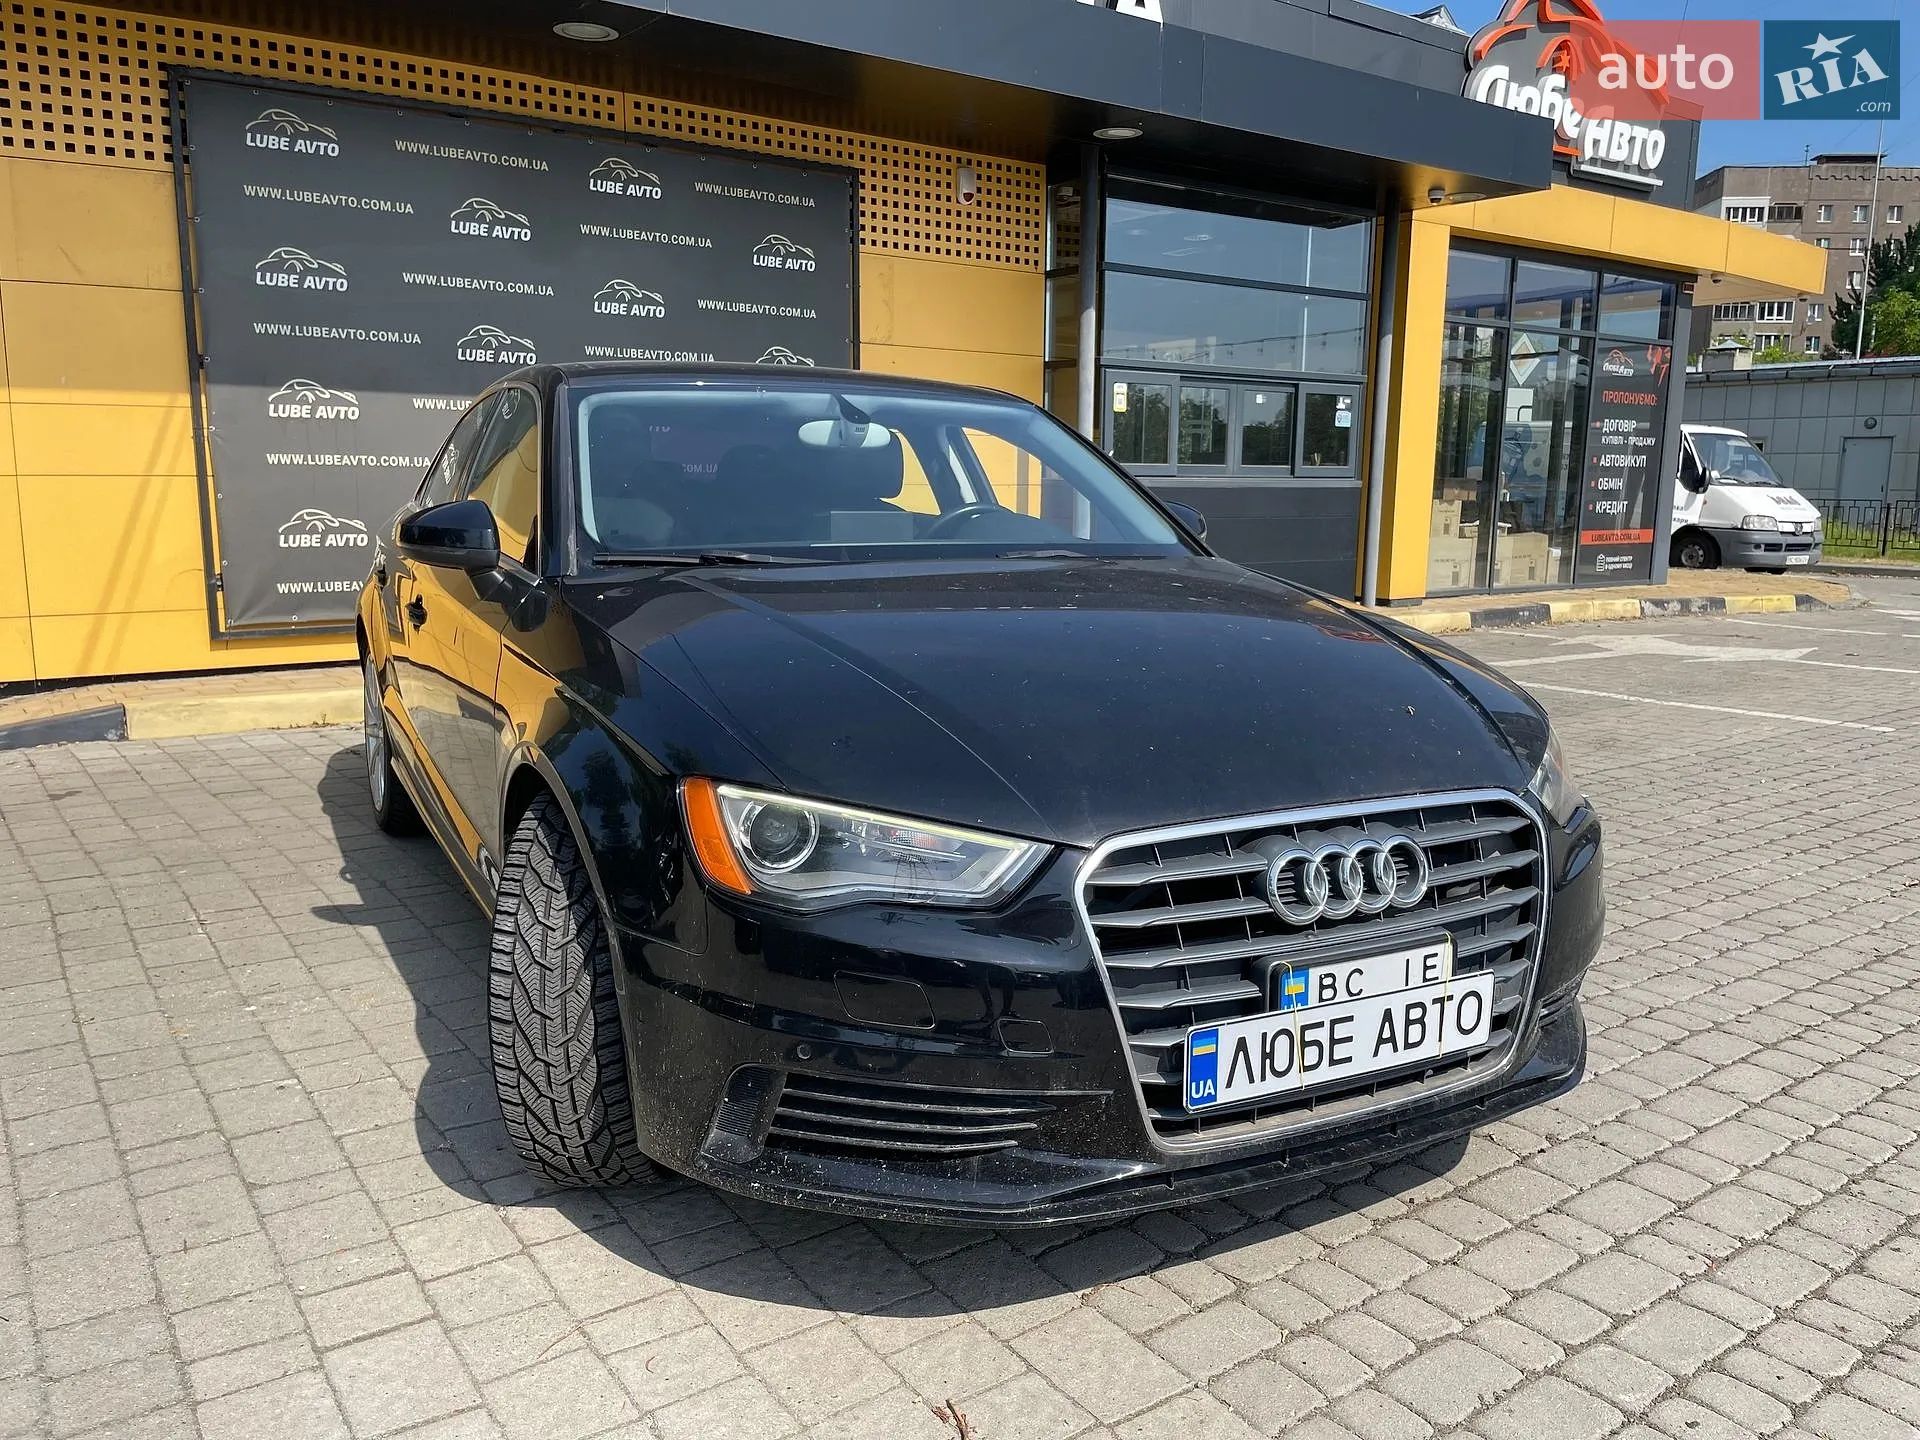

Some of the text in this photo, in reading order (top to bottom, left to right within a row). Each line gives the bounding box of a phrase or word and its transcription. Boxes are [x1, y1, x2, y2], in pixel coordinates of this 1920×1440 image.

[246, 133, 340, 157] LUBE AVTO
[394, 139, 549, 172] WWW.LUBEAVTO.COM.UA
[243, 184, 414, 214] WWW.LUBEAVTO.COM.UA
[589, 178, 662, 200] LUBE AVTO
[694, 182, 816, 208] WWW.LUBEAVTO.COM.UA
[451, 221, 532, 241] LUBE AVTO
[580, 224, 713, 249] WWW.LUBEAVTO.COM.UA
[753, 254, 816, 272] LUBE AVTO
[256, 271, 348, 292] LUBE AVTO
[402, 272, 554, 297] WWW.LUBEAVTO.COM.UA
[594, 302, 665, 319] LUBE AVTO
[697, 299, 817, 320] WWW.LUBEAVTO.COM.UA
[254, 322, 421, 345] WWW.LUBEAVTO.COM.UA
[457, 348, 537, 365] LUBE AVTO
[584, 345, 715, 362] WWW.LUBEAVTO.COM.UA
[1603, 390, 1657, 405] ПРОПОНУЄМО:
[269, 403, 360, 421] LUBE AVTO
[1602, 419, 1637, 433] ДОГОВІР
[266, 453, 431, 468] WWW.LUBEAVTO.COM.UA
[1600, 454, 1646, 467] АВТОВИКУП
[1598, 477, 1623, 490] ОБМІН
[1595, 501, 1628, 515] КРЕДИТ
[279, 533, 369, 549] LUBE AVTO
[1226, 990, 1483, 1089] ЛЮБЕ АВТО
[1191, 1077, 1216, 1099] UA
